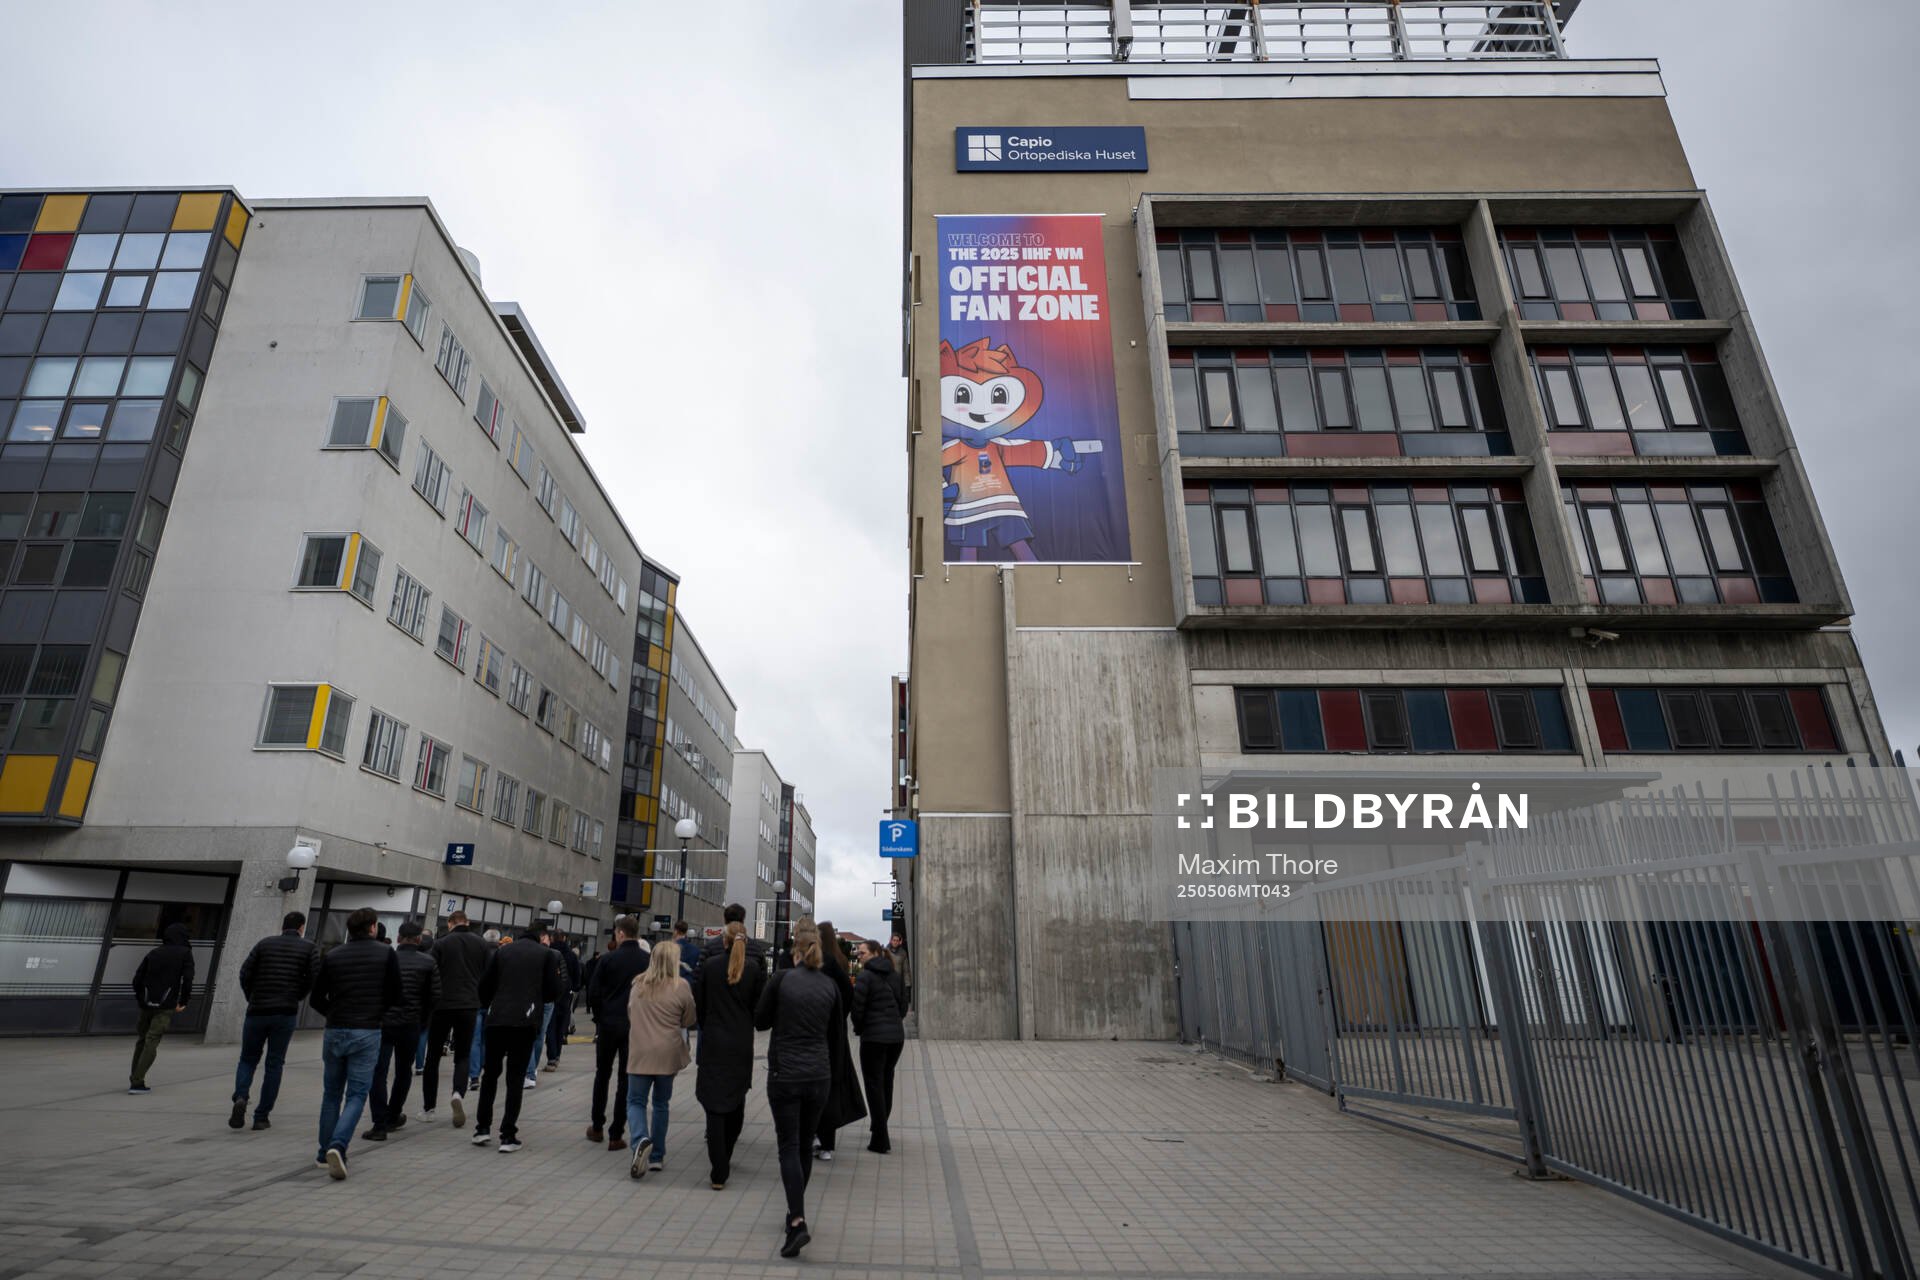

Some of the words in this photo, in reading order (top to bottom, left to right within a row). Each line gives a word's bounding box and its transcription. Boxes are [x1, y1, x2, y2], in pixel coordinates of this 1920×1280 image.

[1008, 136, 1052, 148] Capio
[1008, 150, 1091, 162] Ortopediska
[1095, 150, 1136, 160] Huset
[948, 233, 1021, 246] WELCOME
[1024, 233, 1044, 246] TO
[949, 247, 977, 260] THE
[981, 247, 1019, 260] 2025
[1022, 247, 1051, 260] IIHF
[1055, 247, 1083, 260] WM
[949, 265, 1088, 291] OFFICIAL
[950, 295, 1011, 321] FAN
[1017, 295, 1100, 321] ZONE
[892, 827, 902, 842] P
